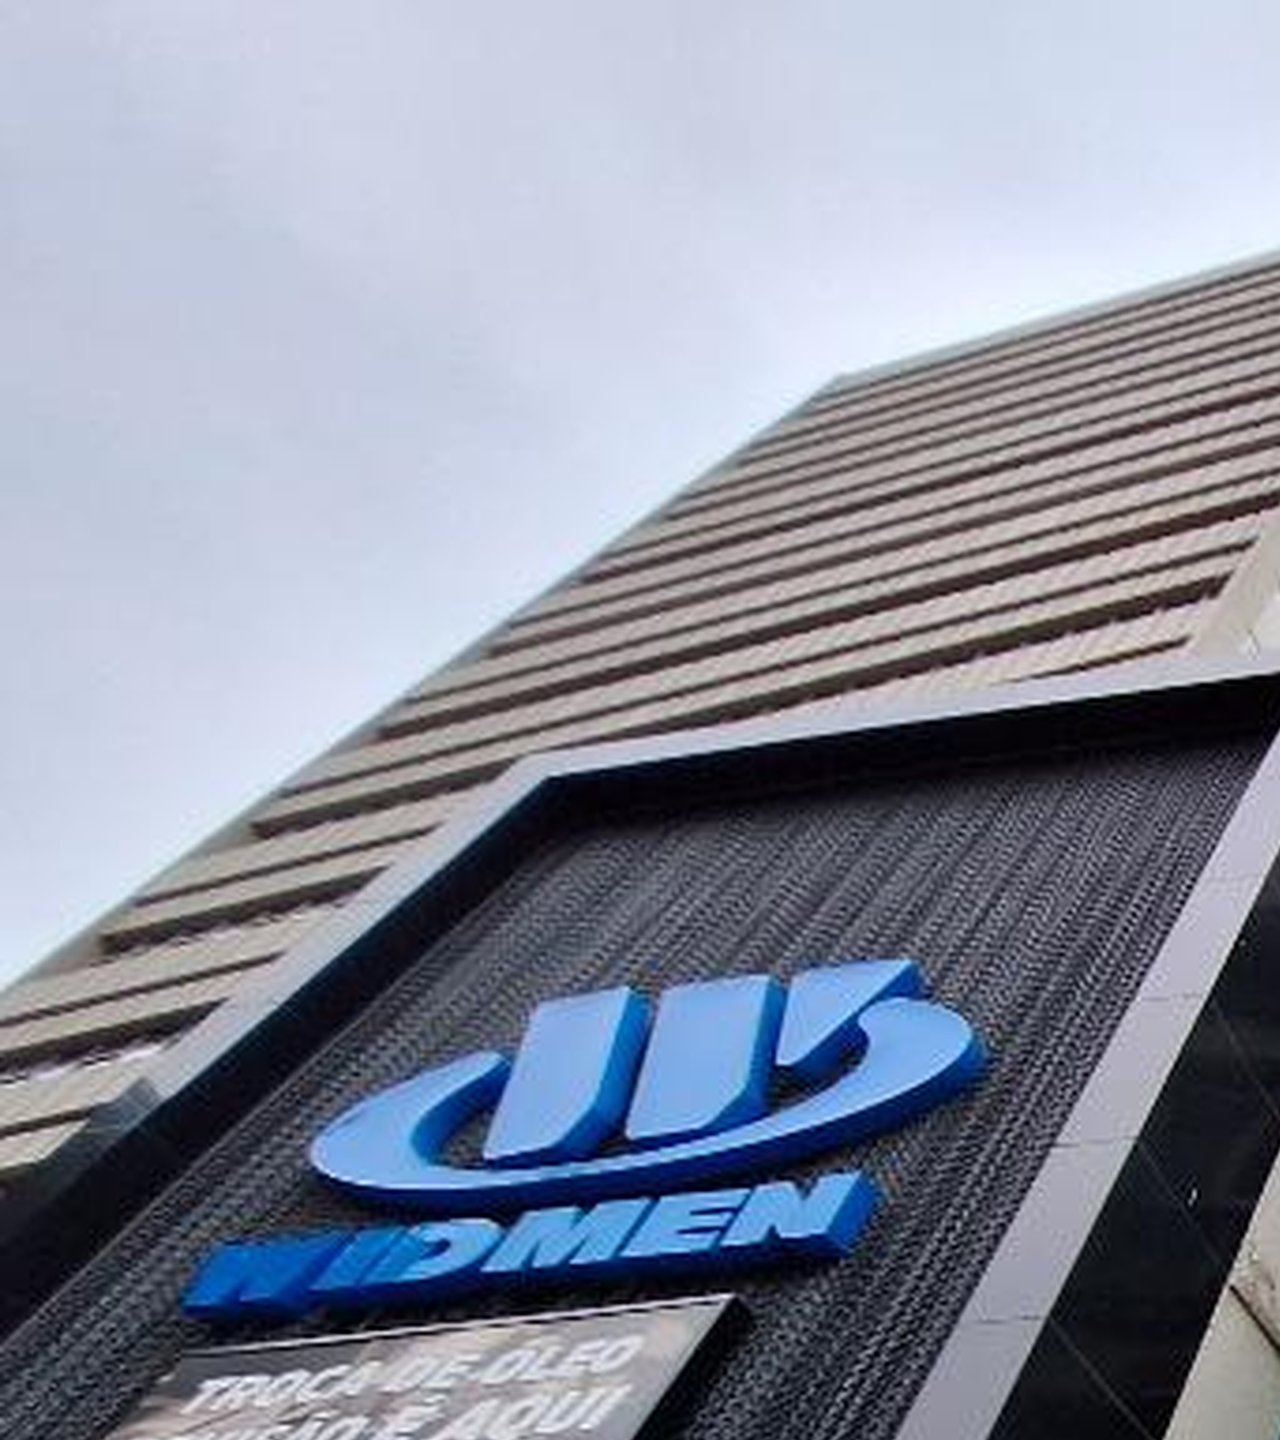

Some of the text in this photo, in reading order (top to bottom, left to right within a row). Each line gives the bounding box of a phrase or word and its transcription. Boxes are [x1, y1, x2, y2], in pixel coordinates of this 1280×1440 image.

[182, 1168, 874, 1314] WIDMEN
[180, 1360, 382, 1415] TROCA
[380, 1352, 478, 1394] DE
